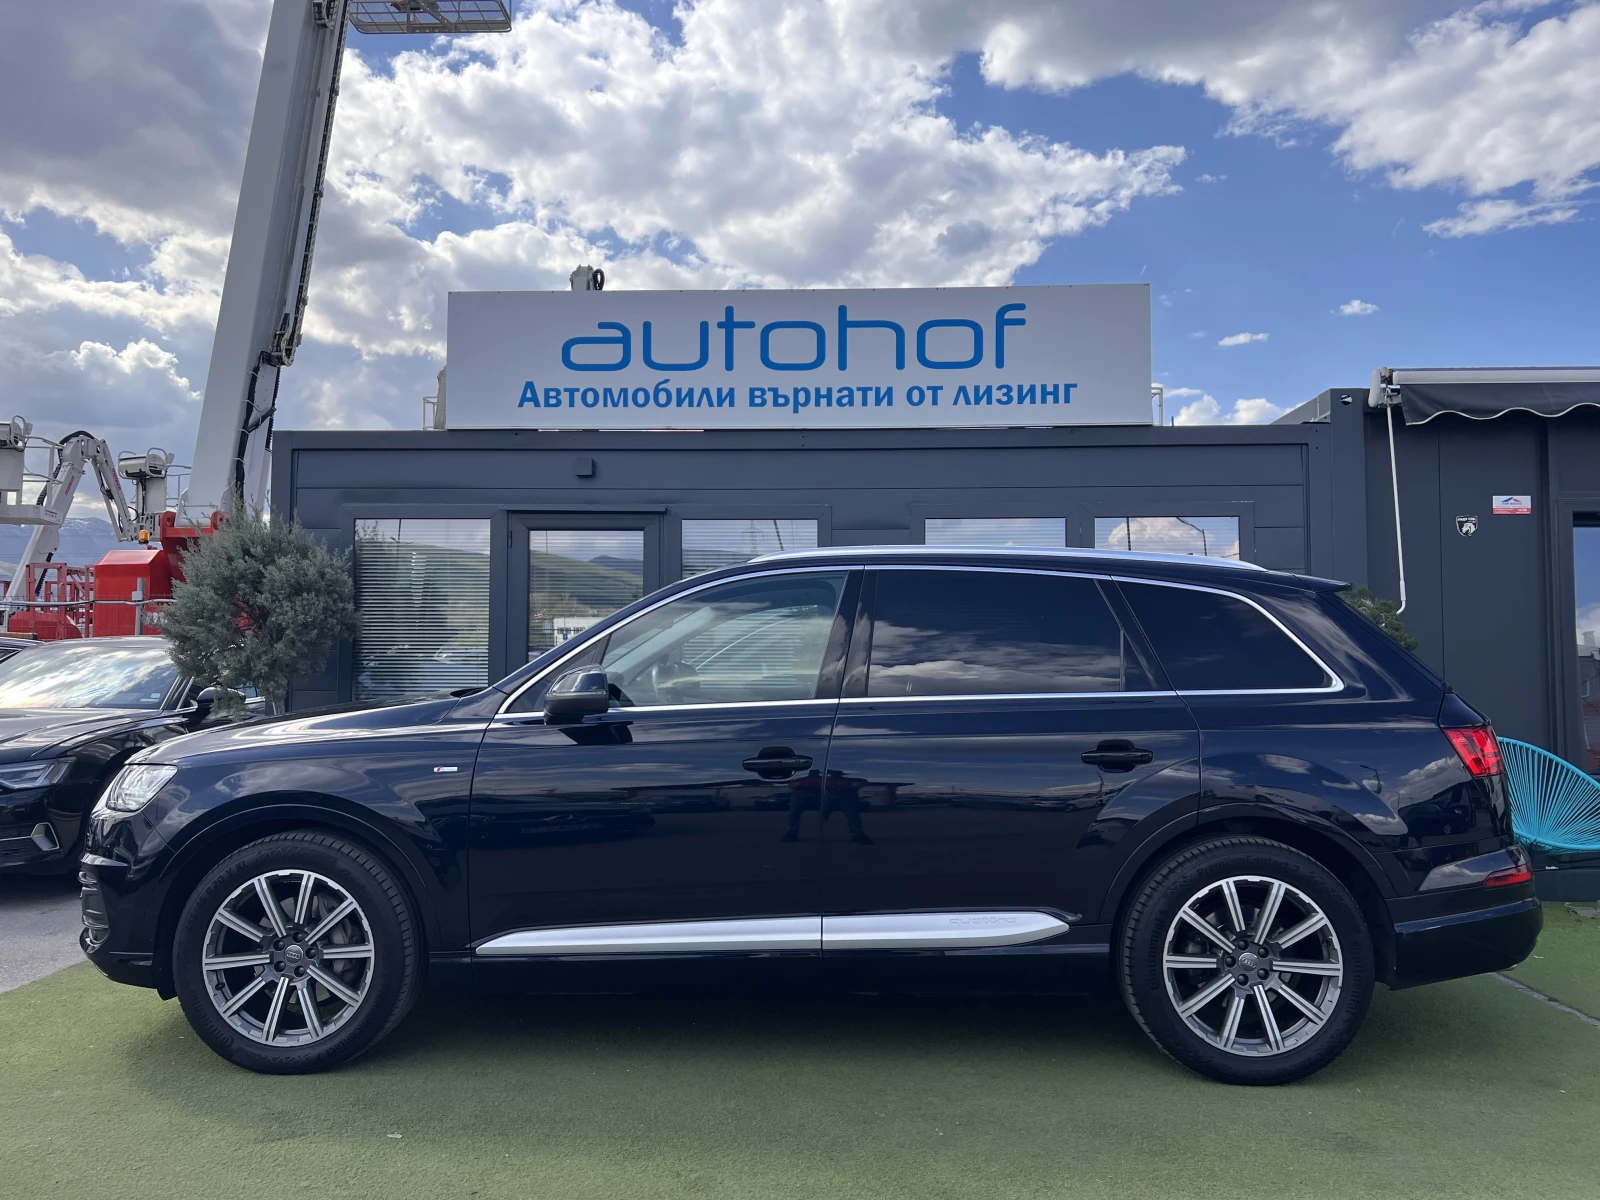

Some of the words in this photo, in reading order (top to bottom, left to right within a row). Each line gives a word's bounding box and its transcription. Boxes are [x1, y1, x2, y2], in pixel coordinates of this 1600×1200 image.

[561, 302, 1027, 372] autohof
[517, 378, 735, 409] Автомобили
[748, 386, 894, 414] върнати
[905, 385, 944, 407] от
[952, 383, 1078, 406] лизинг
[64, 475, 75, 496] mateco
[111, 468, 122, 491] mateco
[949, 916, 1018, 926] quattro
